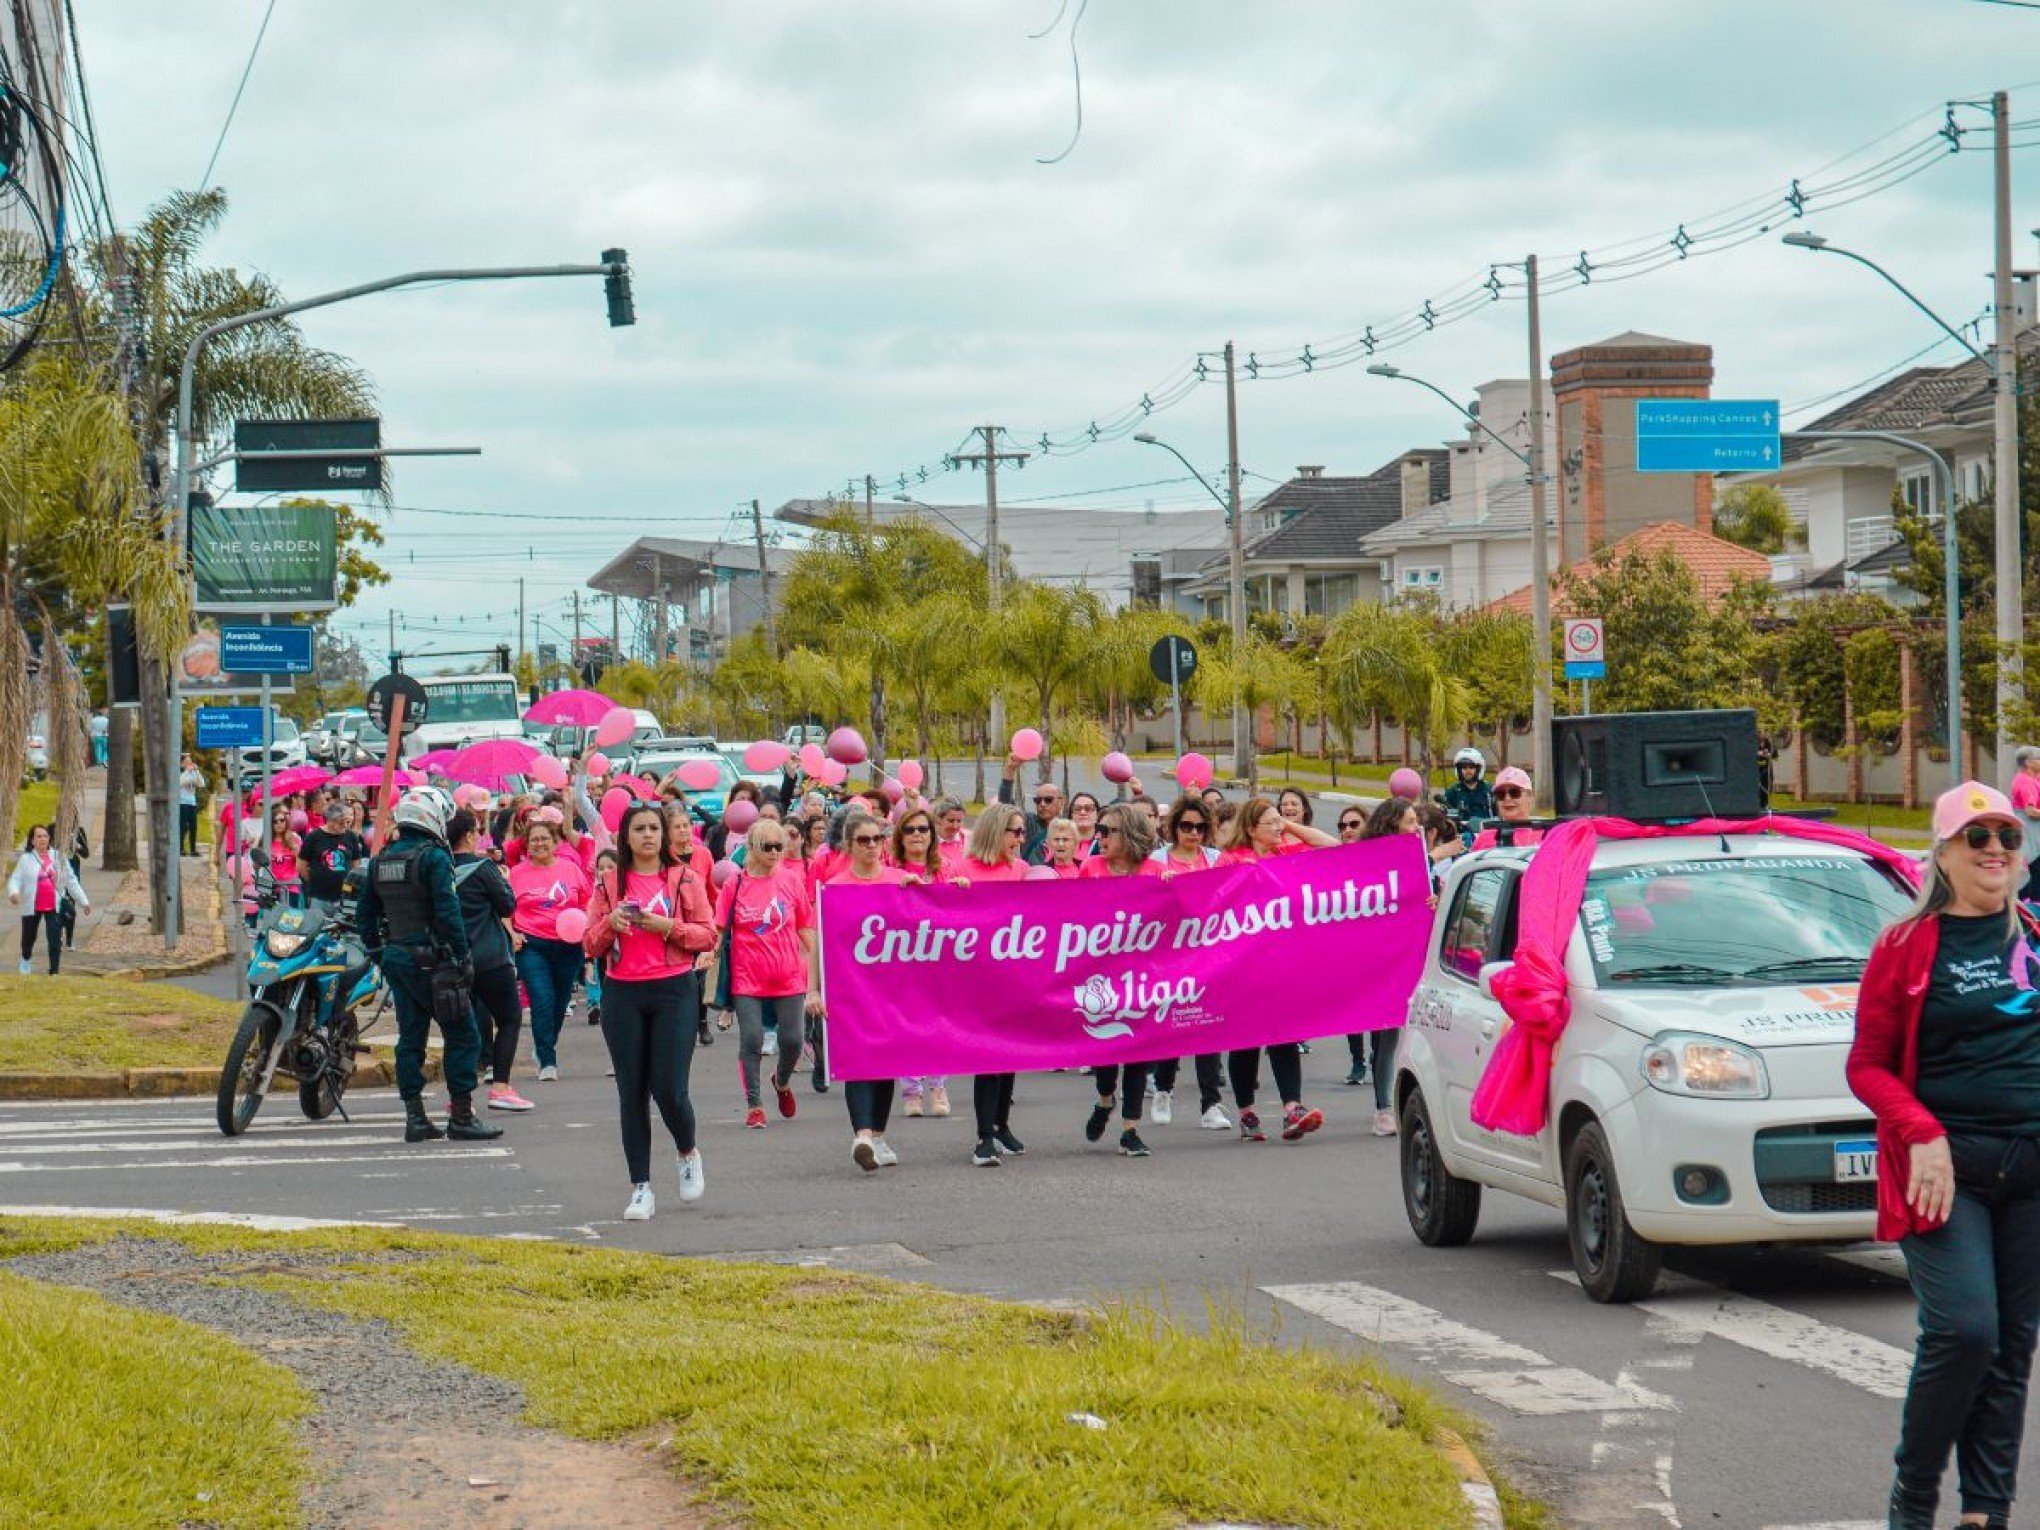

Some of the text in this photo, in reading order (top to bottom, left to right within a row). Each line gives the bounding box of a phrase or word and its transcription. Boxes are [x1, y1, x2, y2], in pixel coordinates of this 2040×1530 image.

[1640, 413, 1757, 424] ParkShopping Canoas
[1714, 448, 1757, 457] Retorno
[208, 540, 321, 553] THE GARDEN
[226, 632, 260, 640] Avenida
[226, 643, 283, 652] Inconfidência
[1624, 858, 1852, 884] JS PROPAGANDA
[854, 869, 1399, 972] Entre de peito nessa luta!
[1114, 970, 1206, 1023] Liga
